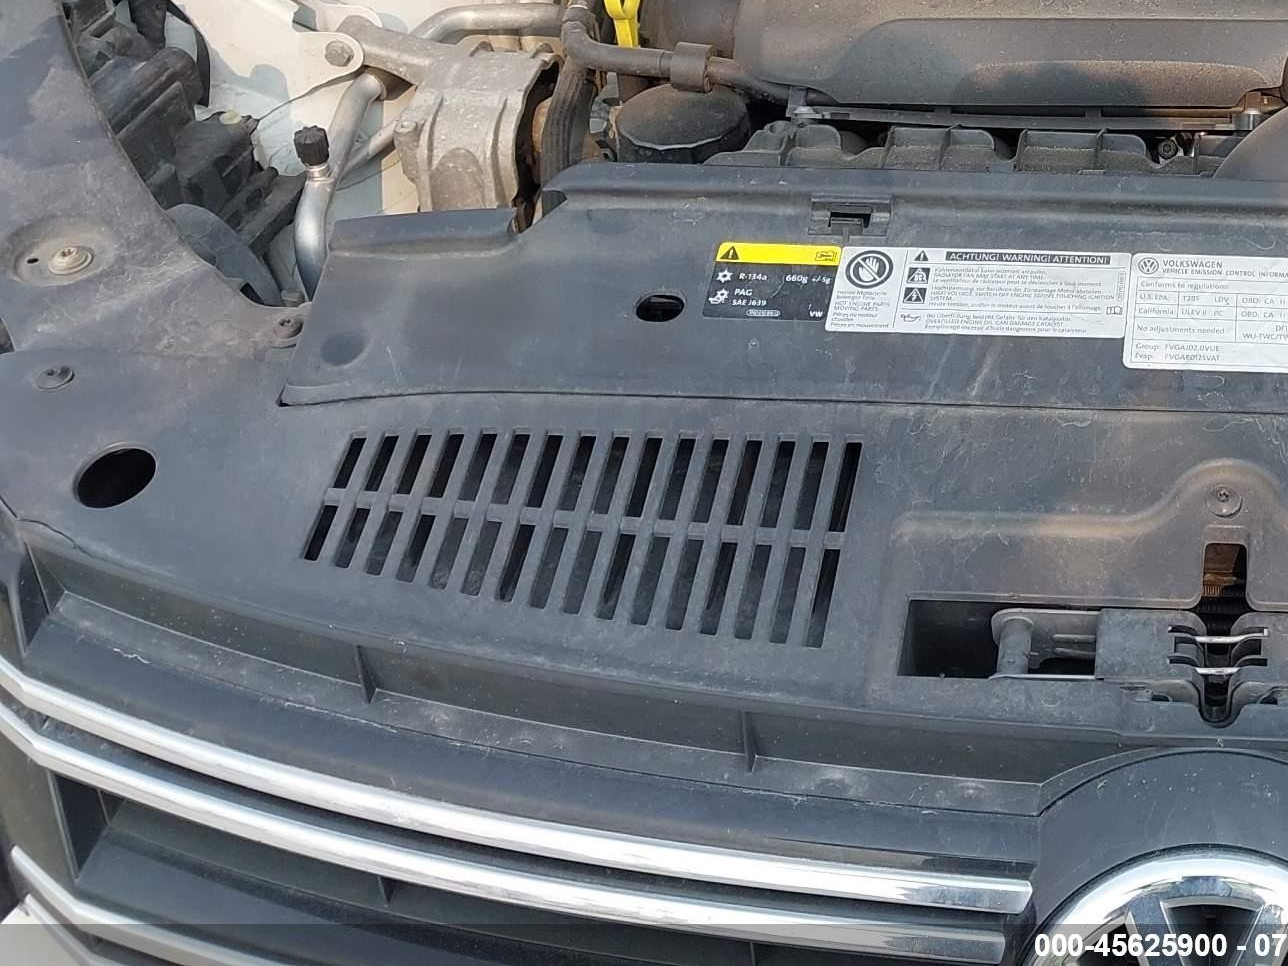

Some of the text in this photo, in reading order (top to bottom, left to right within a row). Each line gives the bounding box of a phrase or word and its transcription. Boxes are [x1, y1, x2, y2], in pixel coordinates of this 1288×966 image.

[949, 253, 1107, 264] ACHTUNG! WARNING! ATTENTION!
[1162, 259, 1223, 268] VOLKSWAGEN
[738, 273, 768, 281] R-134a
[785, 274, 808, 284] 660g
[1186, 282, 1229, 291] regulations:
[734, 288, 753, 296] PAG
[732, 298, 767, 307] SAE J639
[809, 310, 824, 318] VW
[1149, 325, 1195, 335] adjustments
